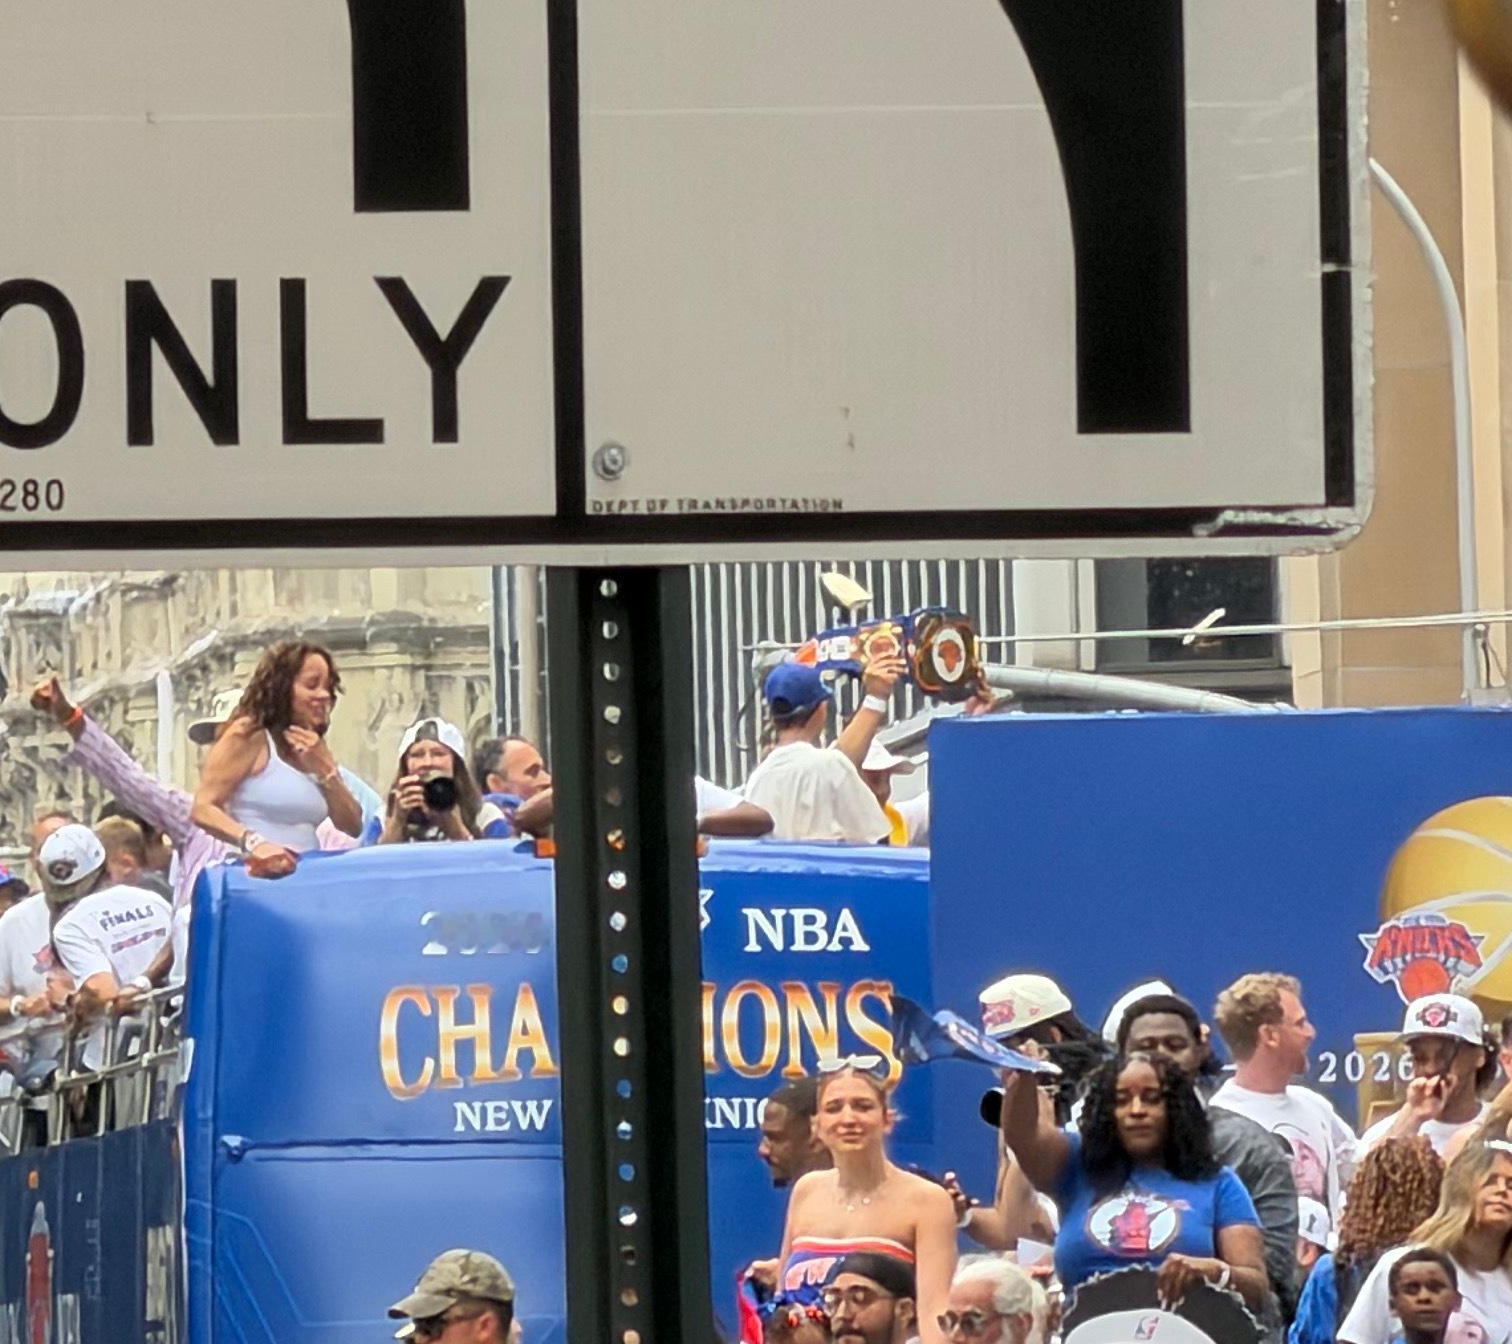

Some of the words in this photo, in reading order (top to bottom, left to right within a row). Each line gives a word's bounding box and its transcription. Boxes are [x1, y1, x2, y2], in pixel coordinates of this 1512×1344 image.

[592, 499, 639, 514] DEPT
[646, 498, 670, 513] OF
[676, 496, 844, 512] TRANSPORTATION
[741, 907, 871, 953] NBA
[1319, 1050, 1415, 1083] 2026
[453, 1099, 553, 1133] NEW
